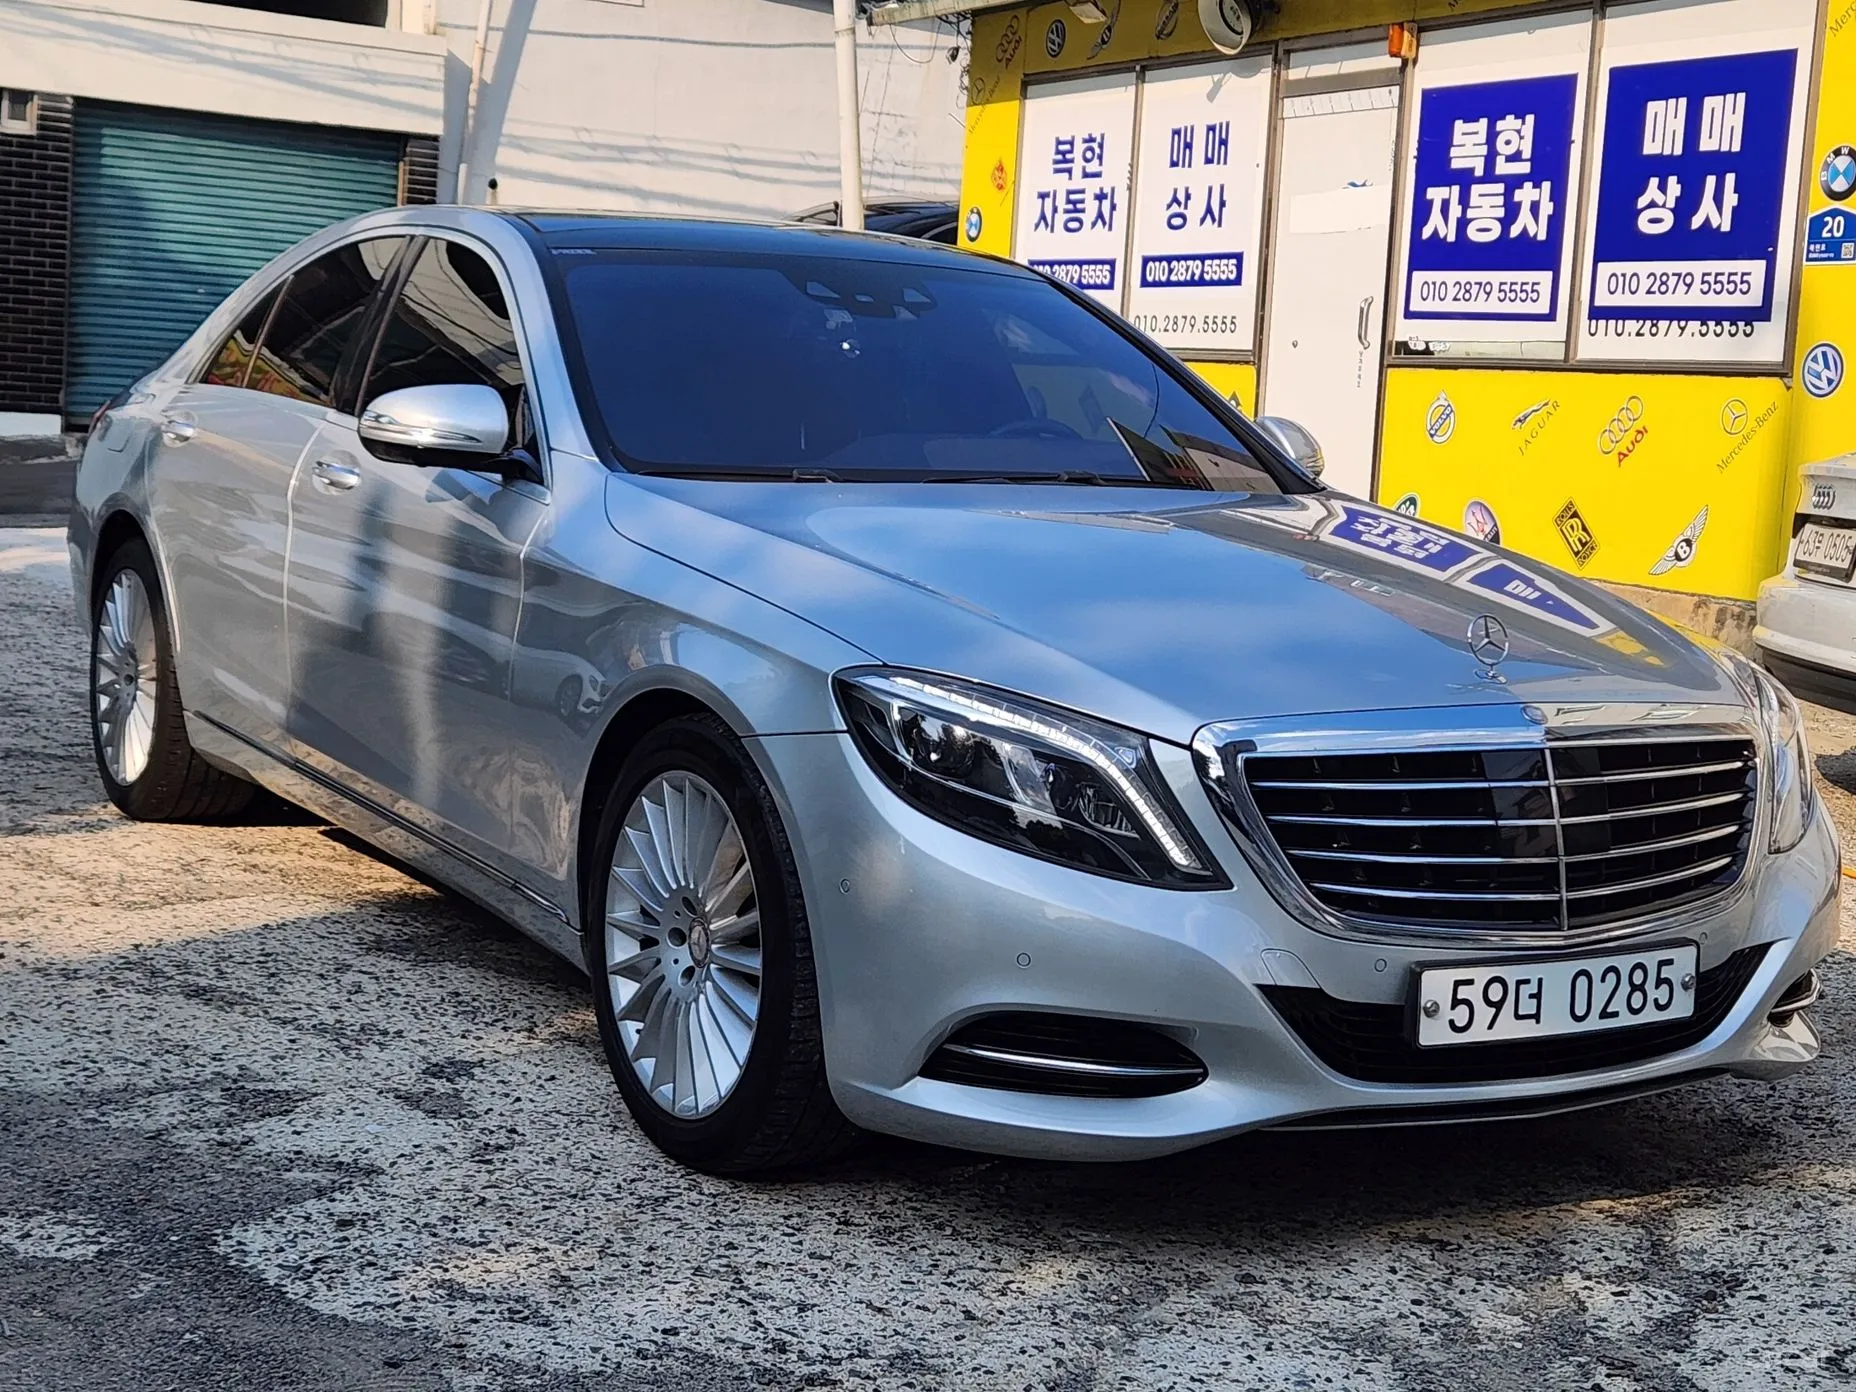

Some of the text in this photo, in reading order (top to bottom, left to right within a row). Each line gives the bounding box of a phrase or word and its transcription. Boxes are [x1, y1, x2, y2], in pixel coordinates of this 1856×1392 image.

[1052, 132, 1105, 181] 복현
[1450, 114, 1535, 177] 복현
[1034, 185, 1117, 234] 자동차
[1421, 180, 1554, 243] 자동차
[1822, 216, 1845, 238] 20
[1081, 264, 1111, 285] 5555
[1146, 258, 1237, 282] 010 2879 5555
[1420, 281, 1541, 303] 010 2879 5555
[1607, 271, 1752, 295] 010 2879 5555
[1429, 405, 1452, 436] VOLVO
[1518, 400, 1560, 456] JAGUAR
[1716, 401, 1778, 474] Mercedes-Benz
[1616, 425, 1648, 468] Audi
[1448, 958, 1675, 1034] 59더 0285
